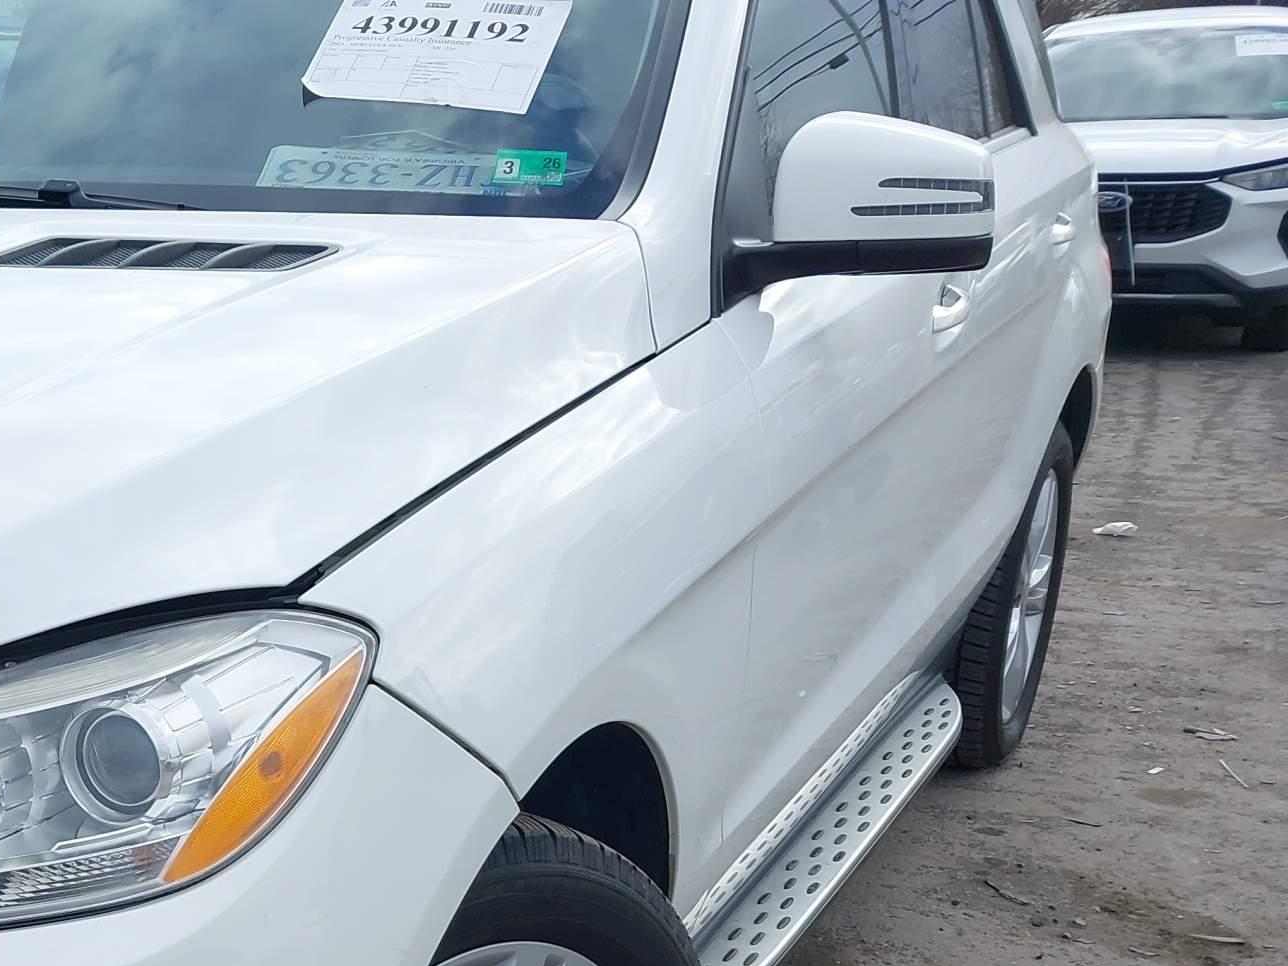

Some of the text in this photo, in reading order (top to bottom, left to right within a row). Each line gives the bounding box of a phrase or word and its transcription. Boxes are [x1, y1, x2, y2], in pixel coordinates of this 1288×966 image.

[351, 14, 530, 43] 43991192
[332, 33, 473, 47] Progressive Casualty Insurance
[503, 160, 515, 175] 3
[543, 156, 562, 169] 26
